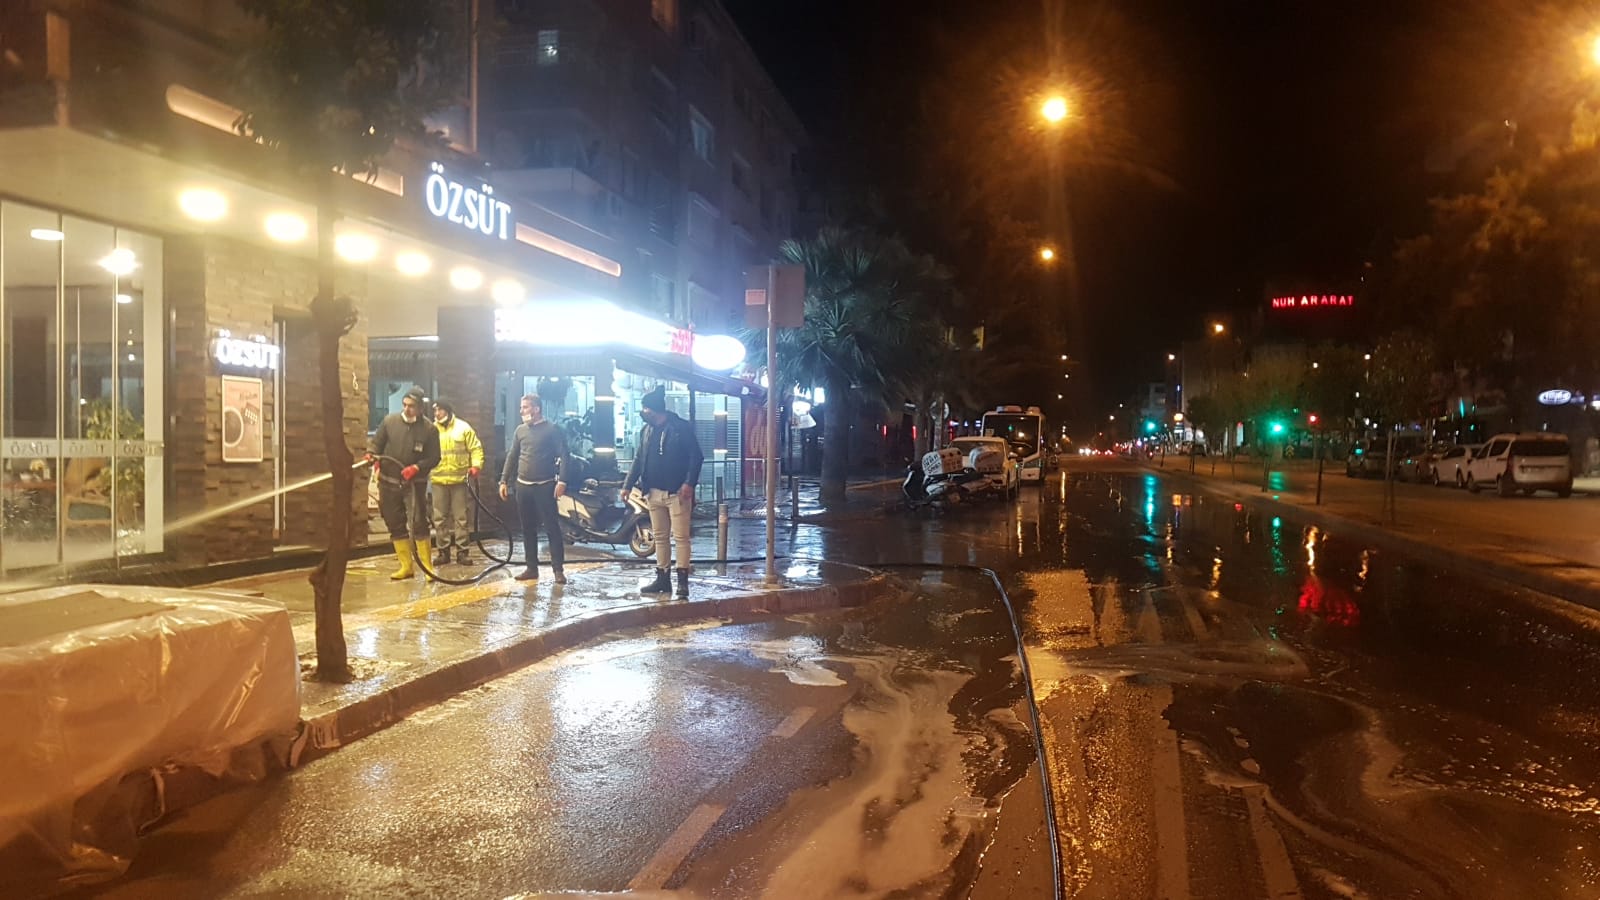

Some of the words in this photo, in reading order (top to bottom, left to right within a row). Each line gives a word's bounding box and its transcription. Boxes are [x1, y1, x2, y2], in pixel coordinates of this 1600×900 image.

[426, 161, 511, 240] ÖZSÜT
[1272, 296, 1295, 308] NUH
[1301, 295, 1353, 306] ARARAT
[215, 328, 280, 370] ÖZSÜT
